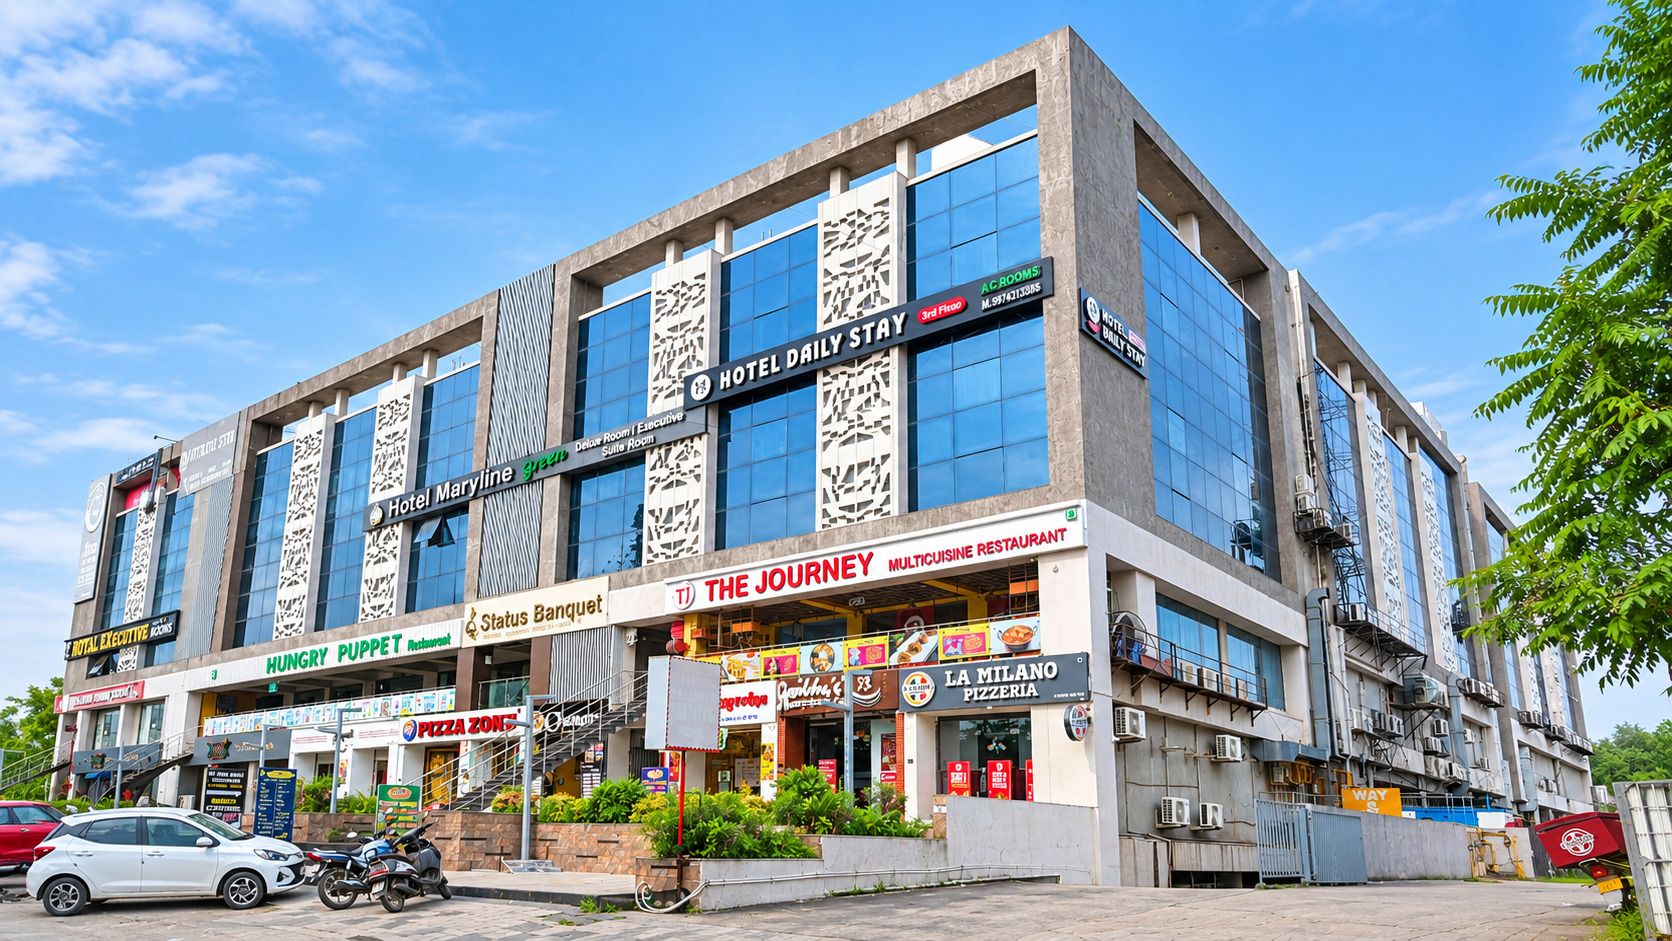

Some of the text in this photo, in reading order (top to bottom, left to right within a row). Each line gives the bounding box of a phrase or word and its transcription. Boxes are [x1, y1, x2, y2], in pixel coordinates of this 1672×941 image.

[999, 265, 1041, 289] ROOMS
[921, 307, 937, 320] 3rd
[720, 311, 906, 391] HOTEL DAILY STAY
[603, 427, 630, 444] Room
[389, 449, 569, 518] Hotel Maryline green
[704, 573, 749, 601] THE
[755, 551, 874, 594] JOURNEY
[888, 544, 973, 572] MULTICUISINE
[977, 527, 1068, 557] RESTAURANT
[481, 610, 529, 632] Status
[533, 594, 603, 624] Banquet
[266, 647, 328, 674] HUNGRY
[337, 633, 403, 662] PUPPET
[945, 662, 1058, 687] LA MILANO
[963, 683, 1039, 702] PIZZERIA
[418, 719, 466, 738] PIZZA
[1352, 789, 1387, 801] WAY
